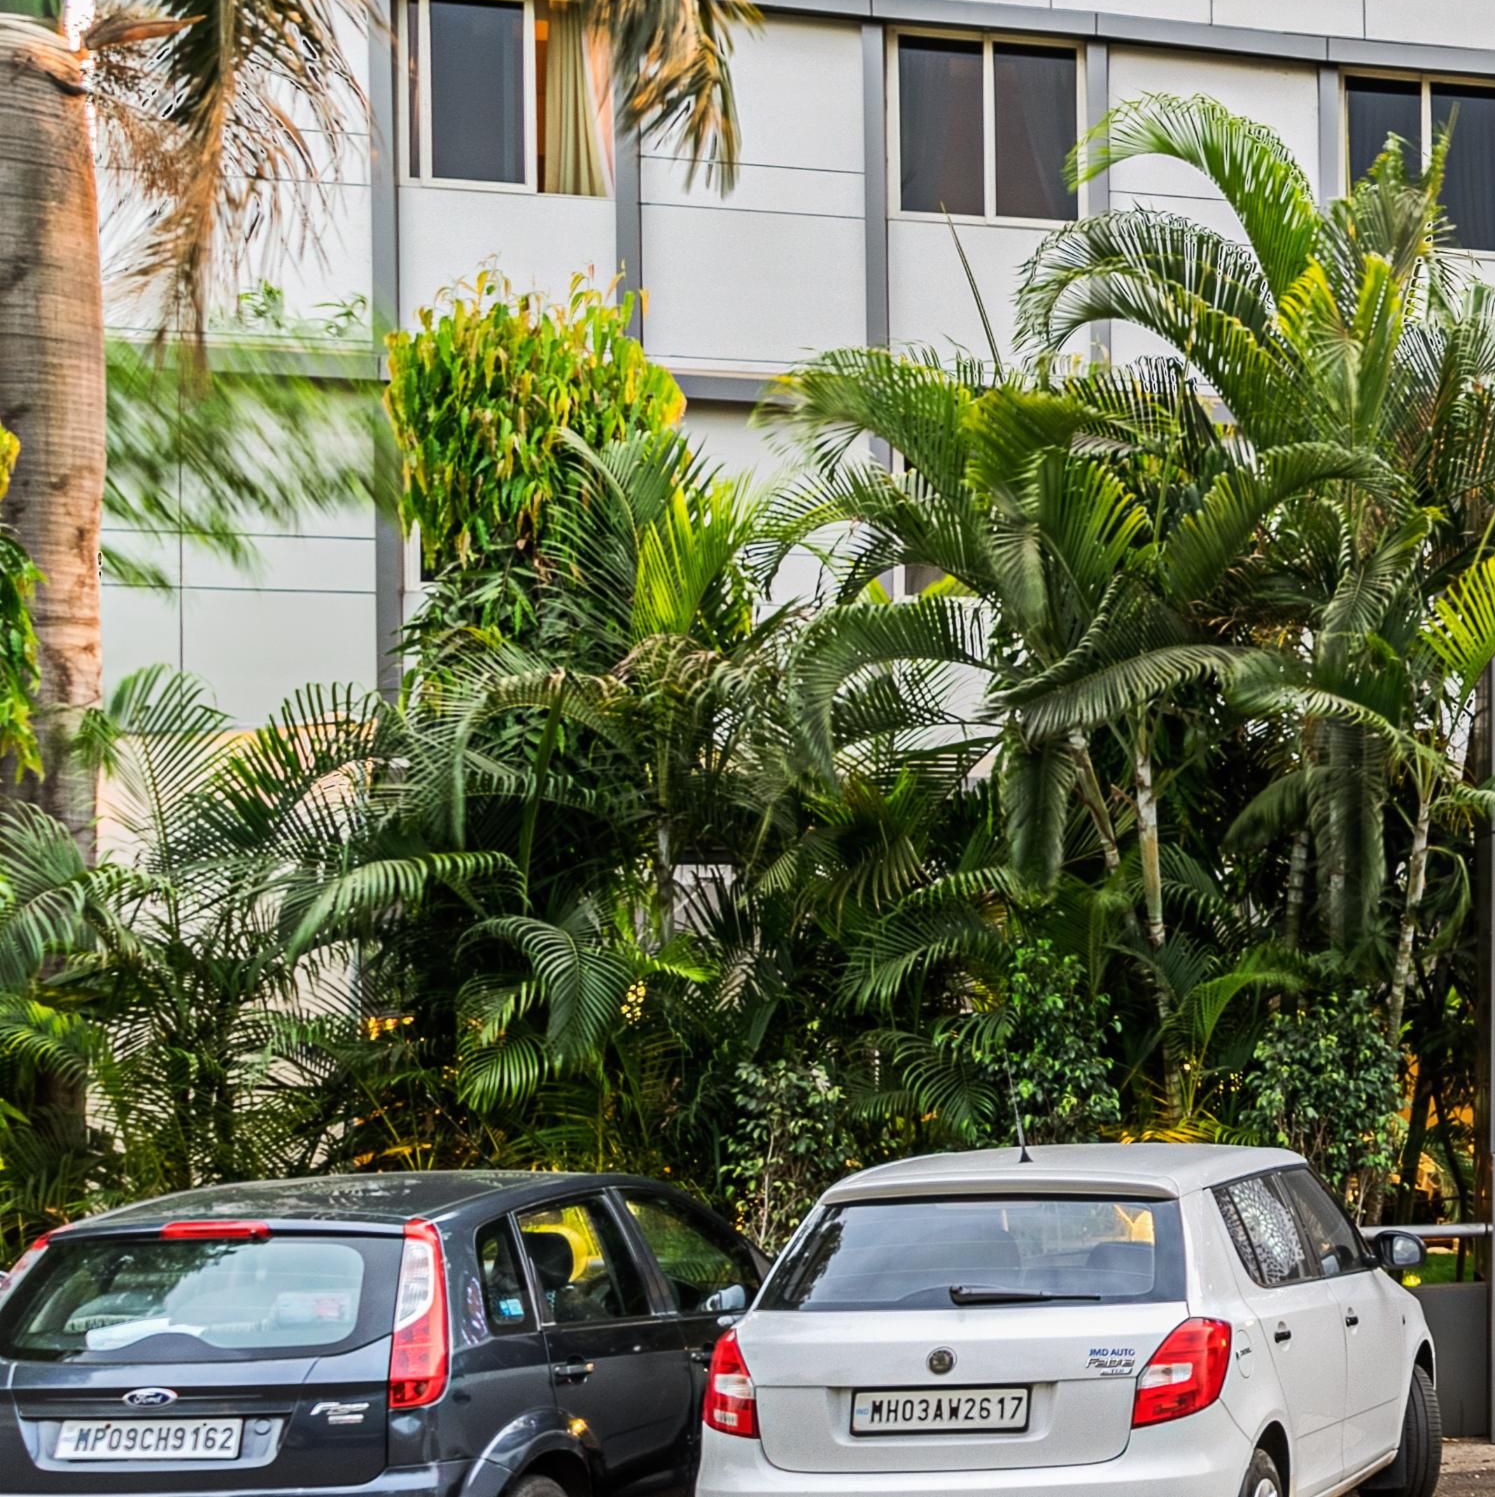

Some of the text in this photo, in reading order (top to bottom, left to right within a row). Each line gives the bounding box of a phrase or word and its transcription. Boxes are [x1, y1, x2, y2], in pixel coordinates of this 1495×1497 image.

[1110, 1348, 1135, 1357] AUTO
[870, 1396, 1024, 1425] MH03AW2617
[73, 1426, 234, 1452] MP09CH9162
